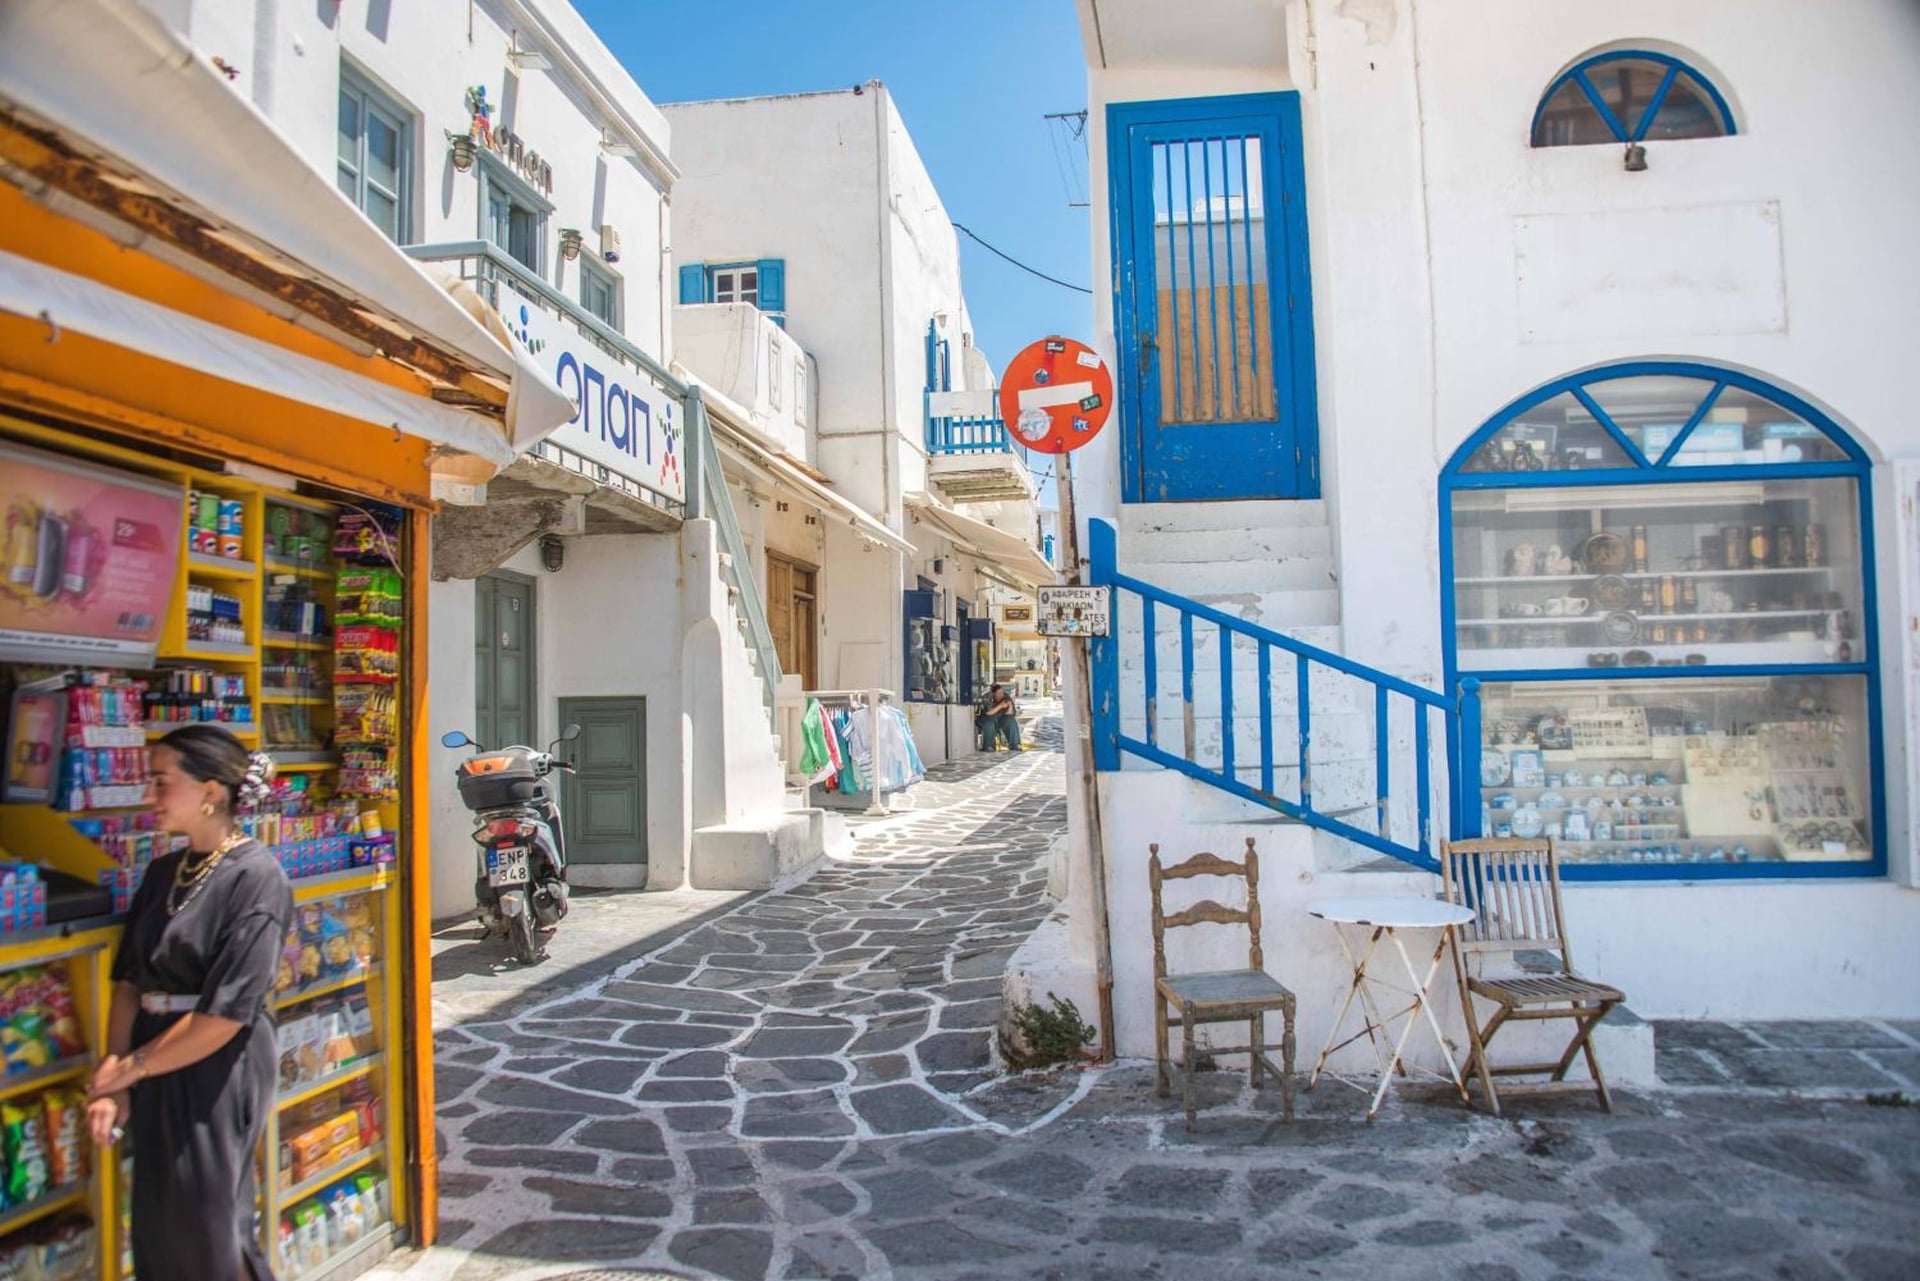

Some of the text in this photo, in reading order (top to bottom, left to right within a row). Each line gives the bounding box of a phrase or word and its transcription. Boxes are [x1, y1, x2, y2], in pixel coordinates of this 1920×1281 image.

[1041, 611, 1070, 622] LICECE
[1074, 613, 1106, 623] LATES
[498, 850, 524, 865] ENP
[500, 867, 527, 882] 348
